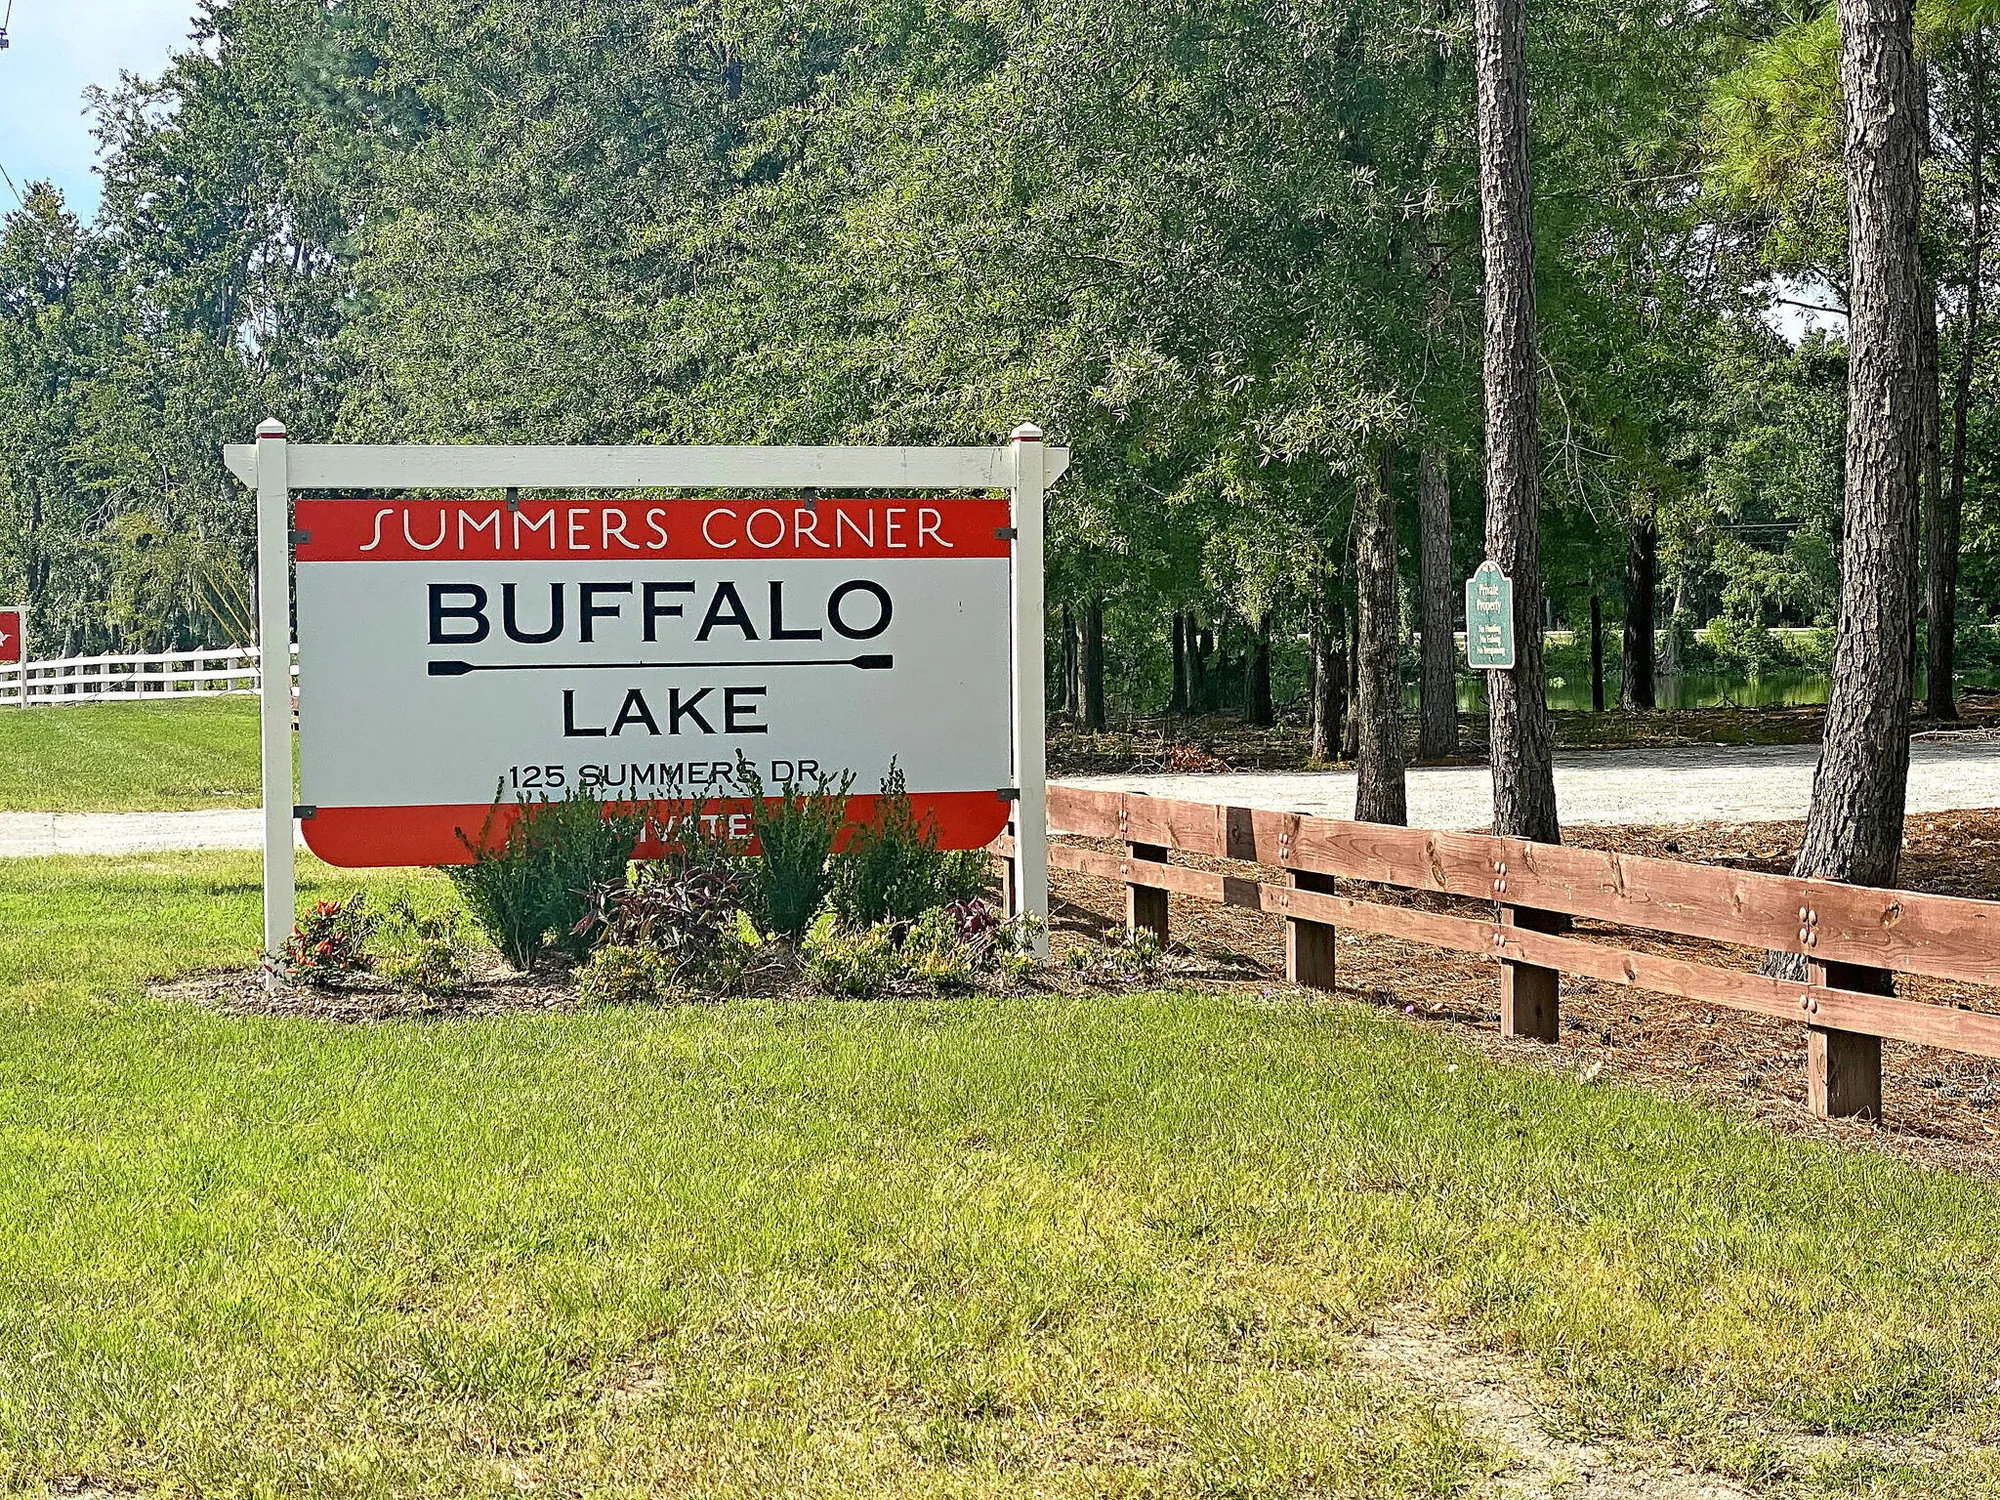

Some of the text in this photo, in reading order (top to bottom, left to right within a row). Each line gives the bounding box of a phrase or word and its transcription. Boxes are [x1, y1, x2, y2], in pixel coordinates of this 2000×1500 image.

[359, 506, 955, 552] SUMMERS CORNER
[427, 579, 893, 645] BUFFALO
[561, 685, 769, 738] LAKE
[509, 764, 566, 789] 125
[577, 760, 758, 787] SUMMERS
